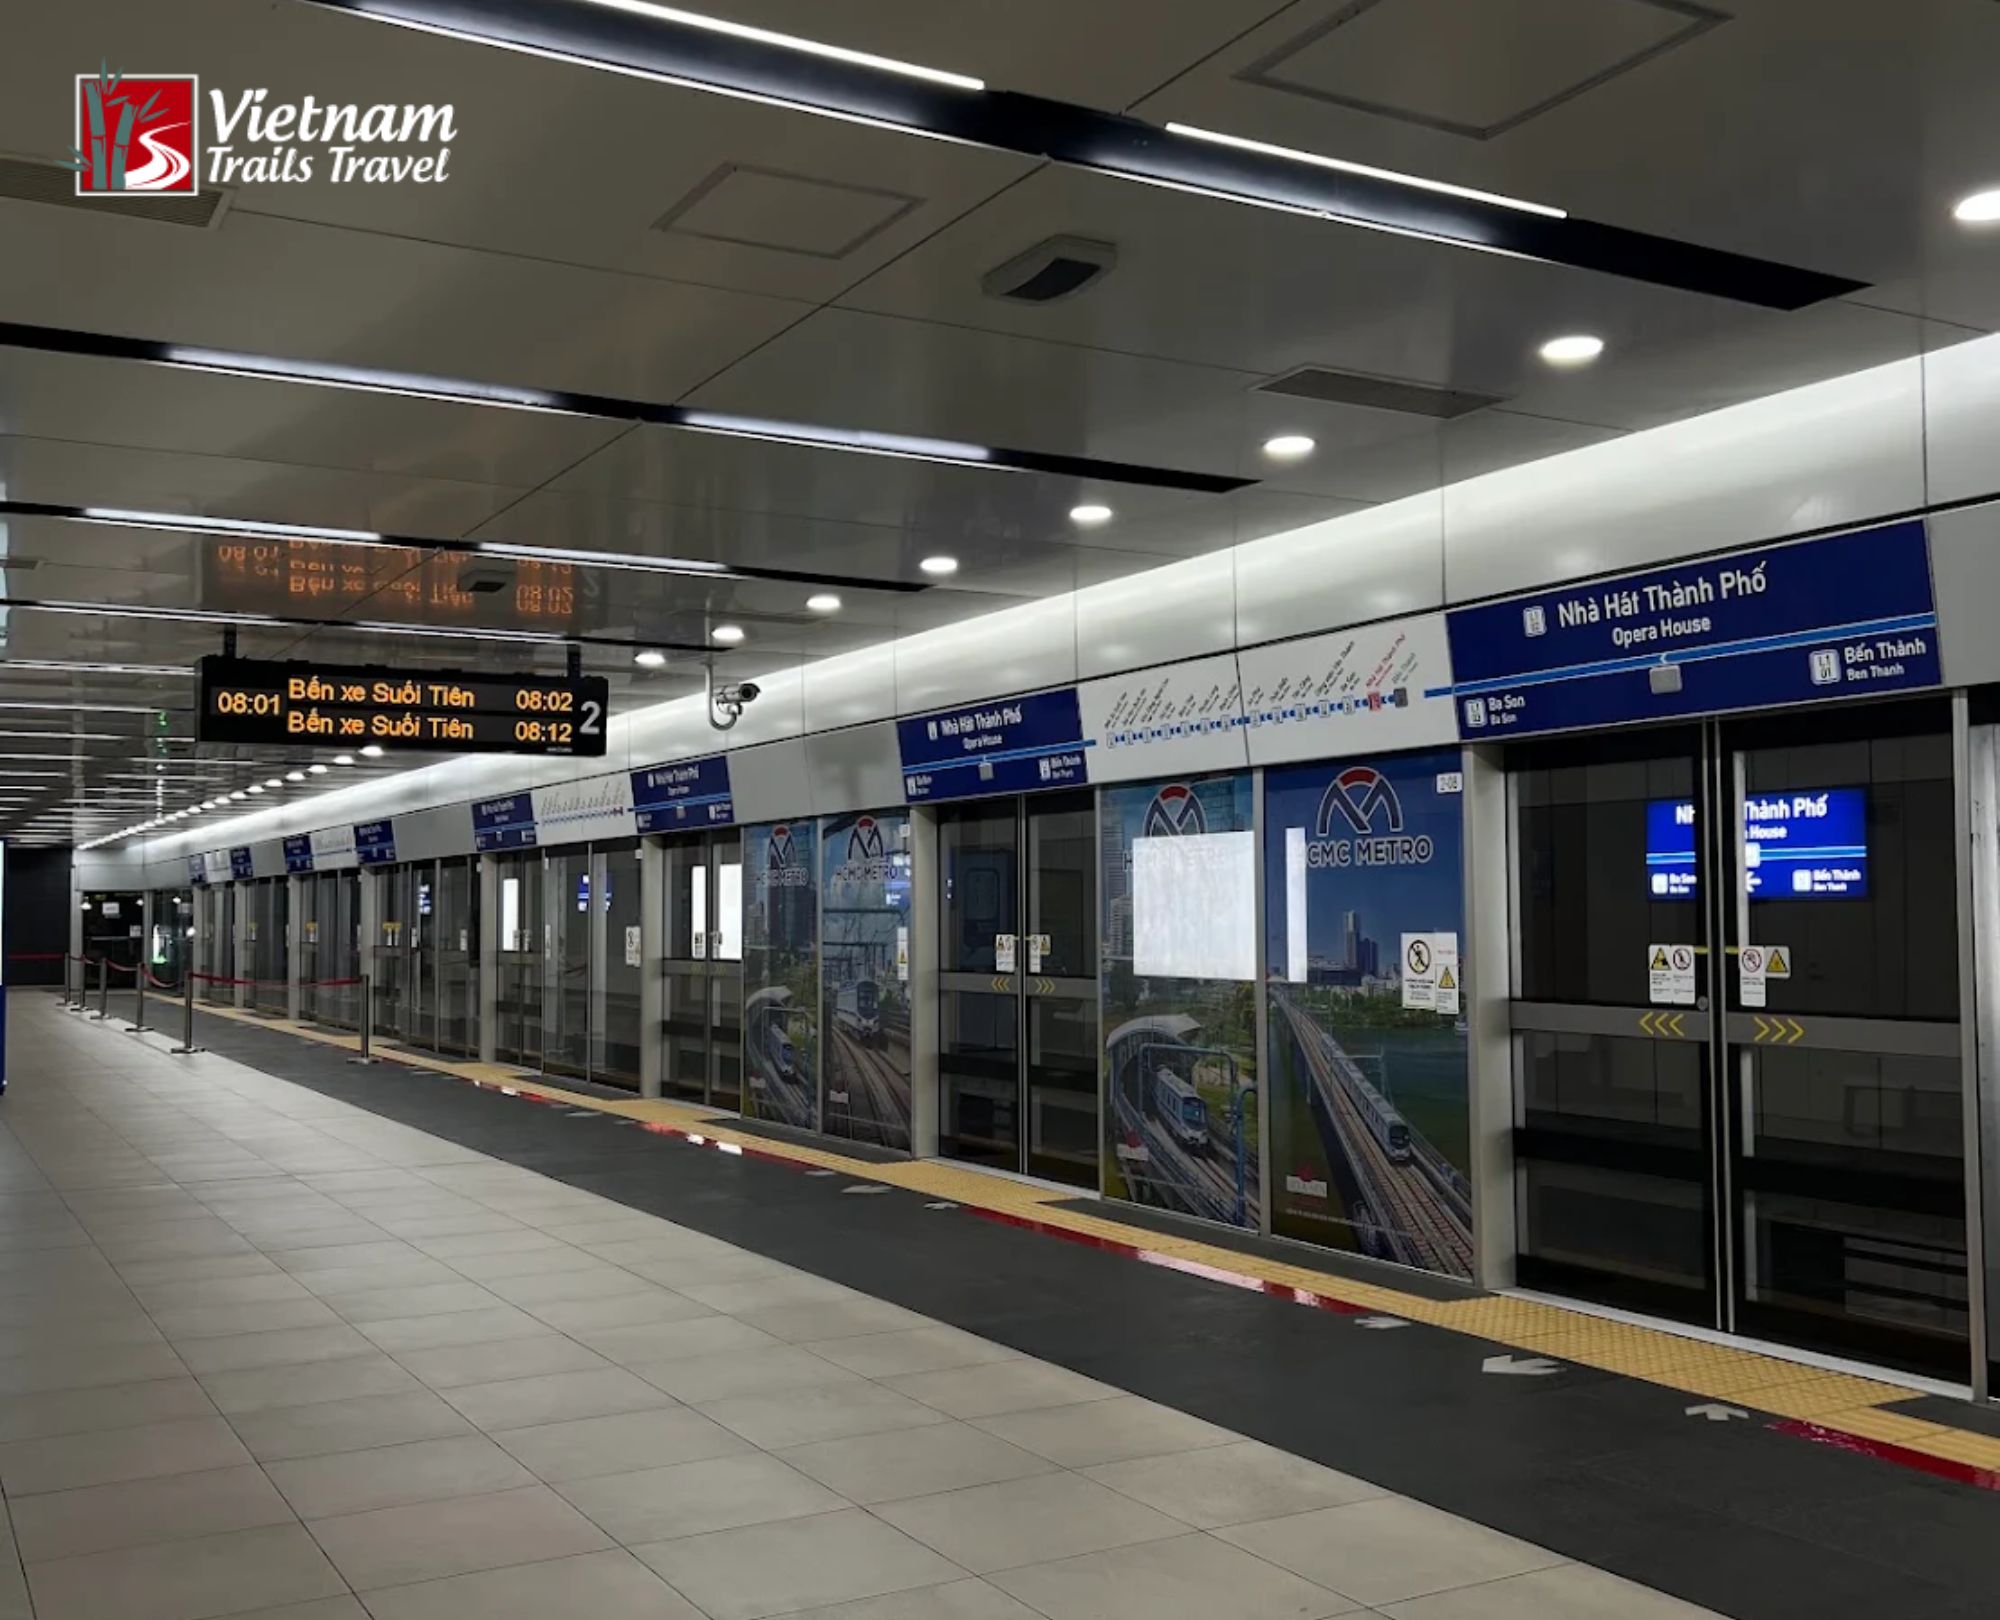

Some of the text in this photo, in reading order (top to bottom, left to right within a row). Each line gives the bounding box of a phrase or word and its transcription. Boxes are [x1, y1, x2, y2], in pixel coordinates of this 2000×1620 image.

[1557, 597, 1600, 628] Nhà
[1604, 591, 1640, 620] Hát
[1643, 576, 1714, 612] Thành
[1719, 560, 1767, 599] Phố
[1612, 616, 1711, 648] Opera House
[1844, 638, 1926, 664] Bến Thành
[1846, 662, 1905, 681] Ben Thanh
[217, 691, 281, 715] 08:01
[288, 675, 573, 712] Bến xe Suối Tiên 08:02
[287, 707, 573, 743] Bến xe Suối Tiên 08:12
[579, 701, 602, 735] 2
[1792, 793, 1829, 818] Phố
[1750, 825, 1787, 839] House
[1299, 834, 1433, 868] CMC METRO
